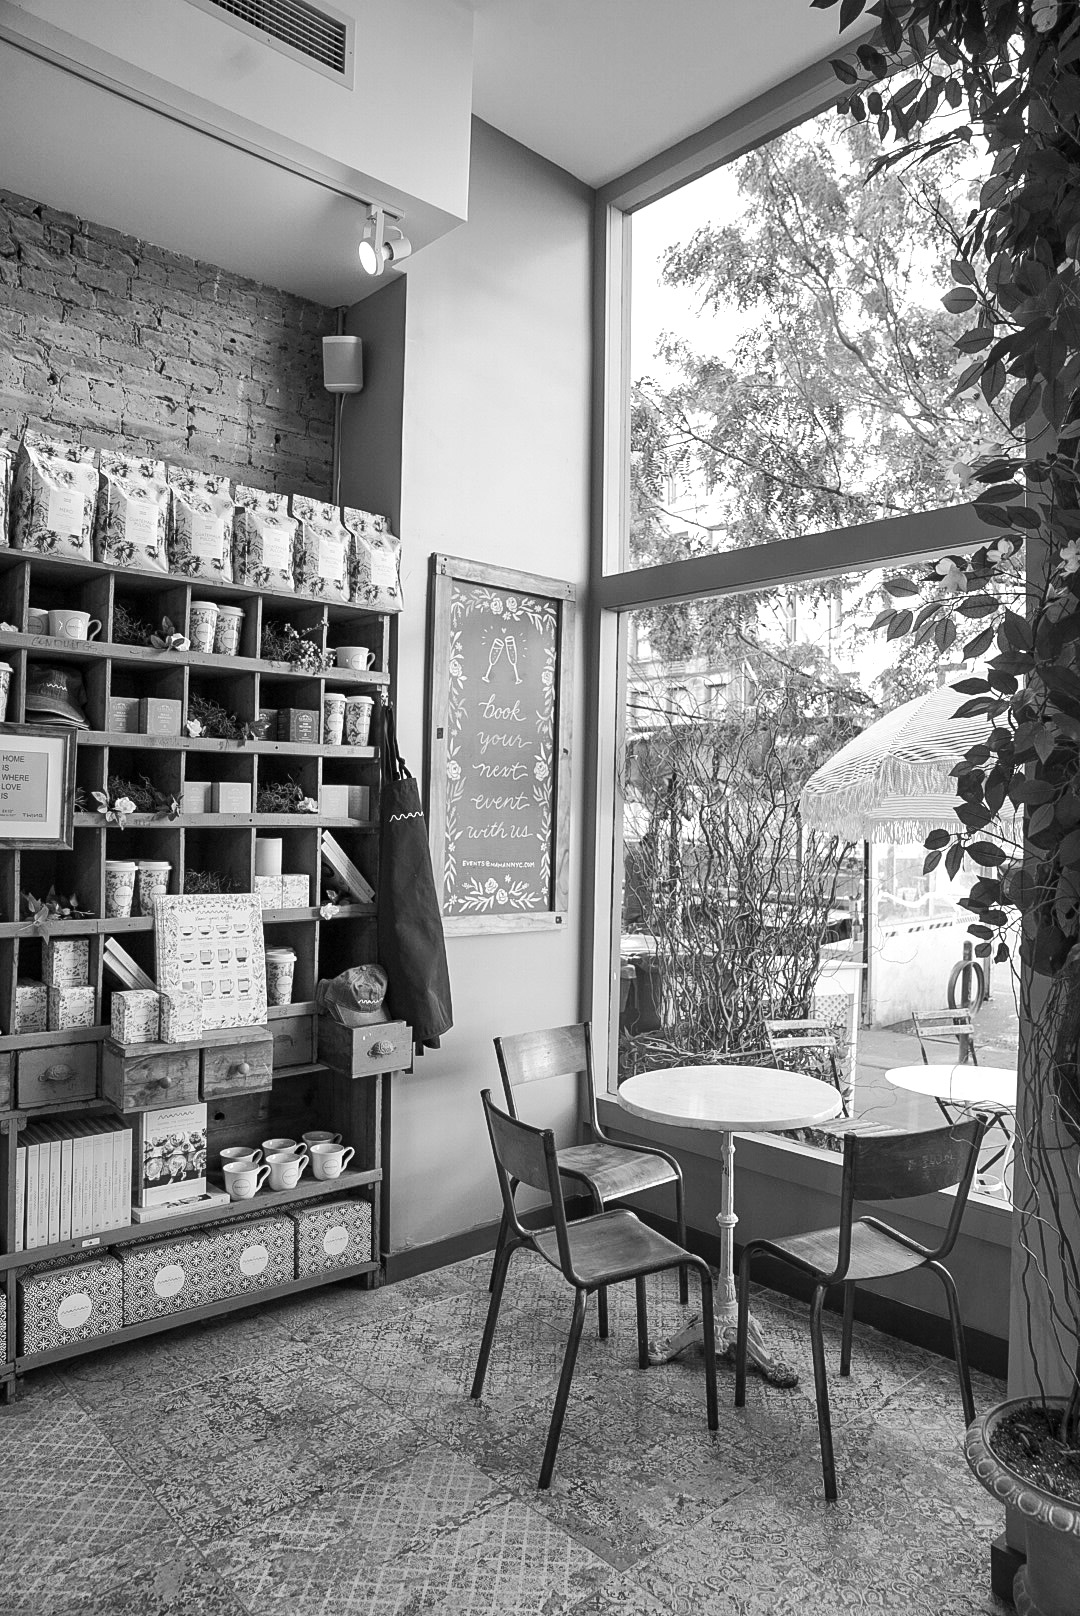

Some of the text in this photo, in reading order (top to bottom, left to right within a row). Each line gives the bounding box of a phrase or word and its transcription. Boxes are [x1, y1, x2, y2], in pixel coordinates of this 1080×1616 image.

[478, 694, 527, 721] book
[477, 731, 532, 754] your
[2, 755, 25, 763] HOME
[1, 774, 30, 782] WHERE
[472, 762, 528, 780] next
[1, 783, 22, 791] LOVE
[0, 792, 9, 800] IS
[470, 792, 530, 810] event
[466, 822, 533, 839] with us
